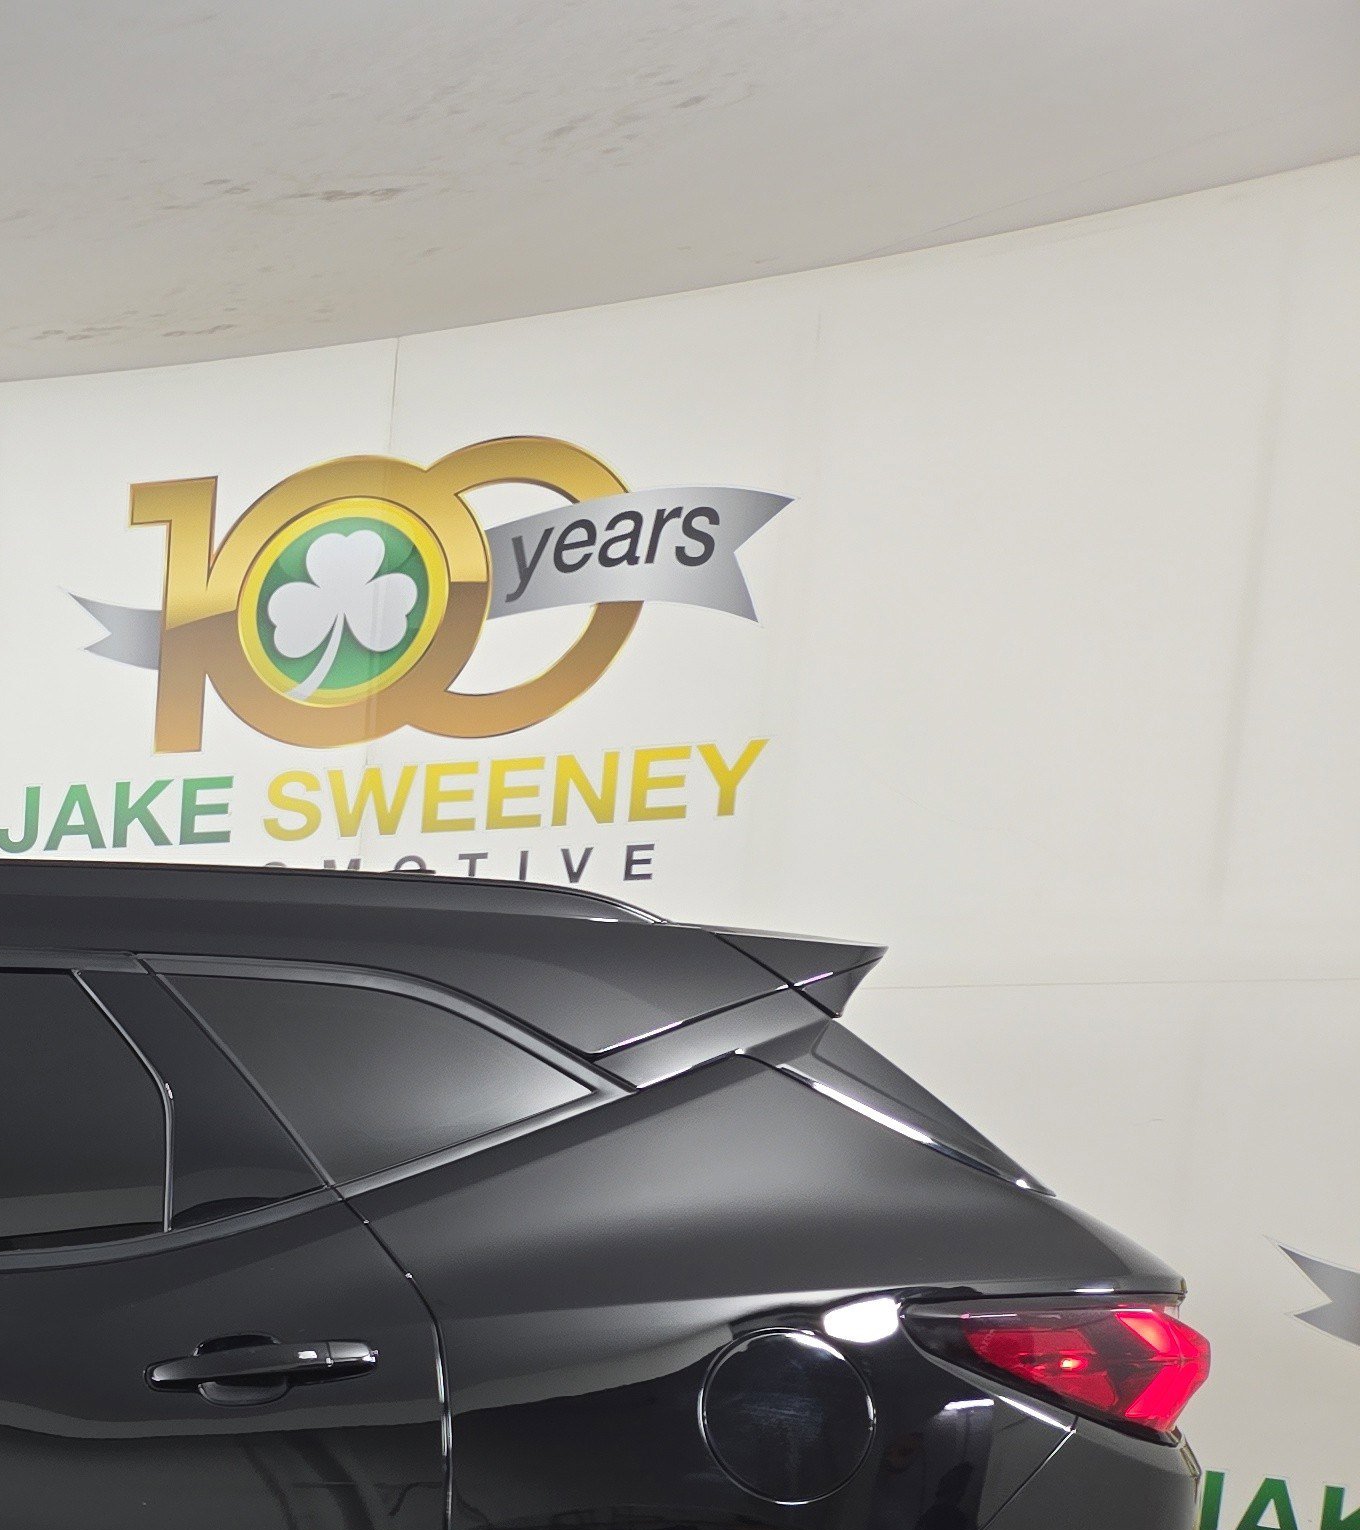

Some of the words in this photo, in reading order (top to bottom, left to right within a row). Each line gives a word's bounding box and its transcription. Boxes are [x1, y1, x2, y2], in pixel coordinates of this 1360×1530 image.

[128, 436, 643, 754] 100
[505, 505, 720, 602] years
[263, 739, 770, 842] SWEENEY
